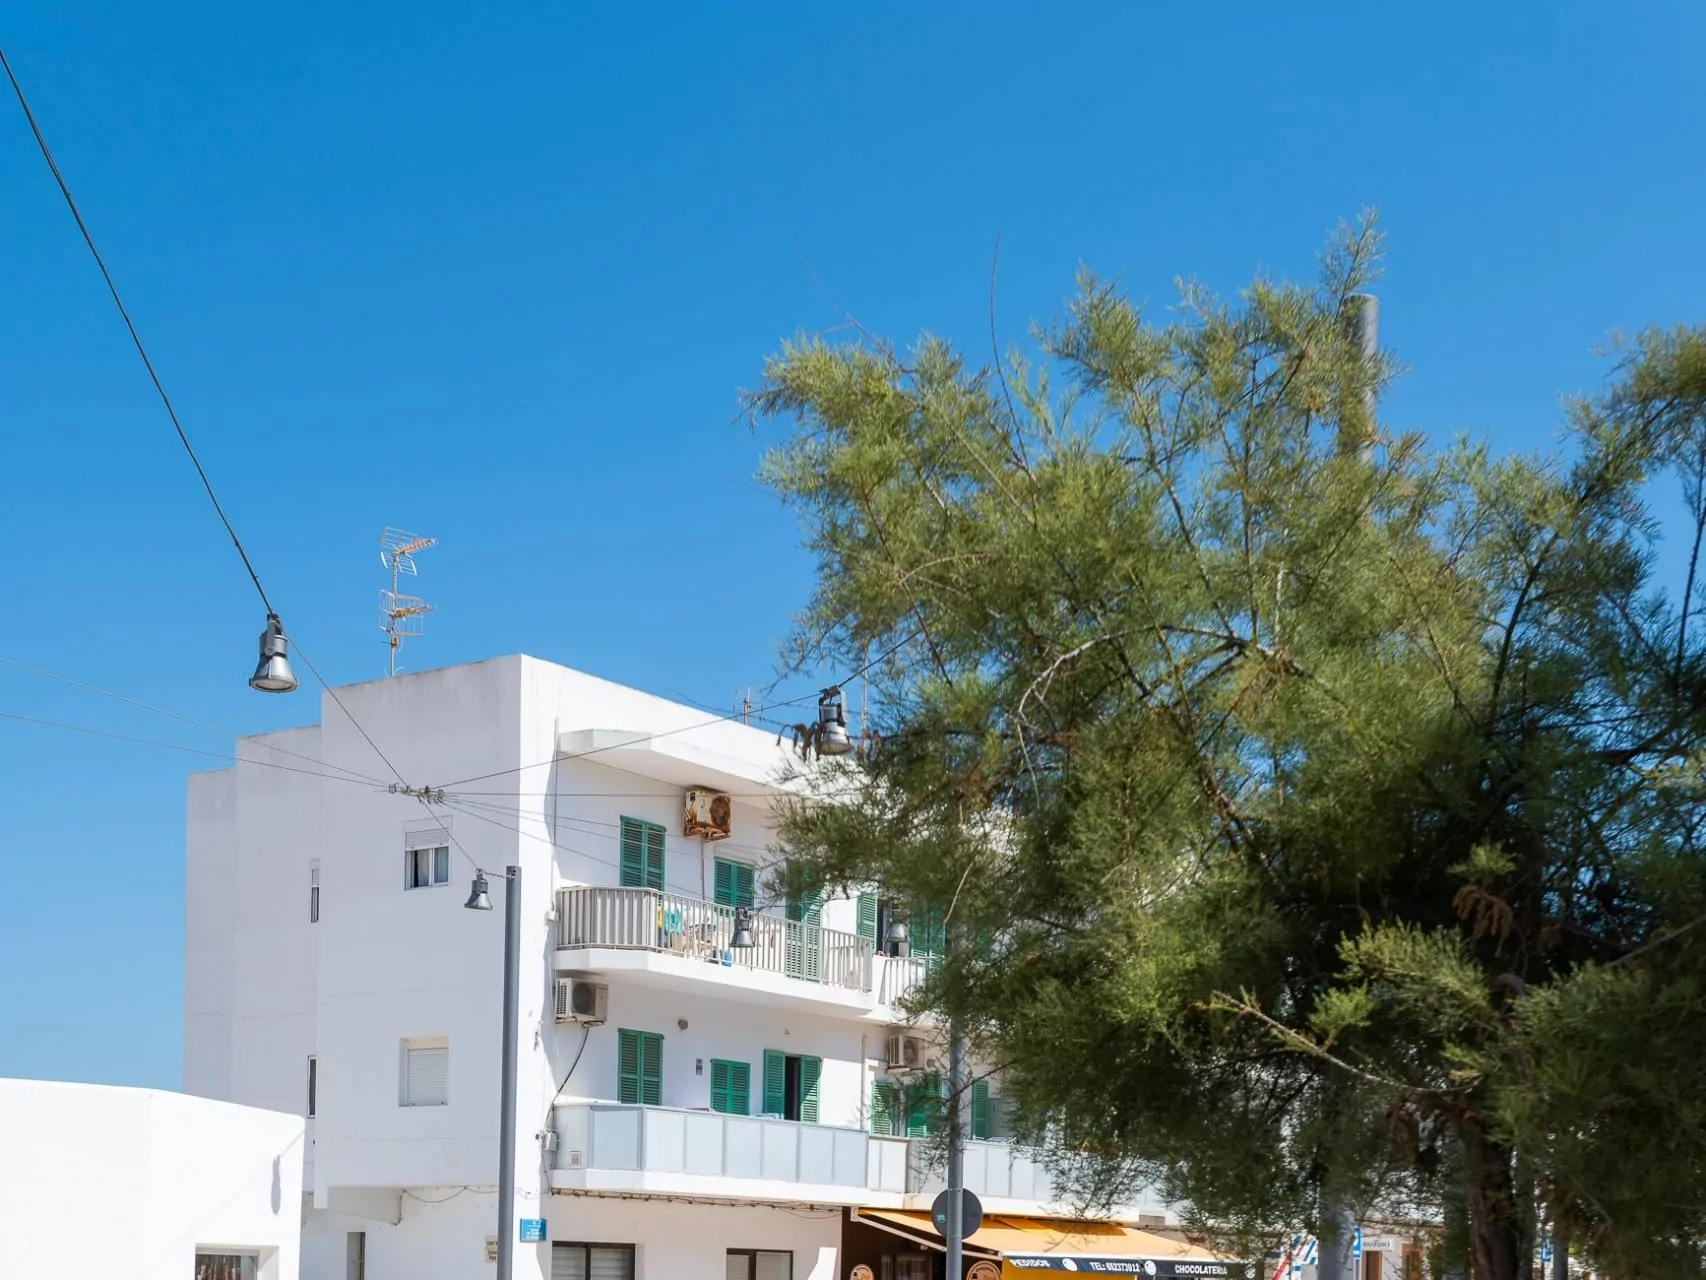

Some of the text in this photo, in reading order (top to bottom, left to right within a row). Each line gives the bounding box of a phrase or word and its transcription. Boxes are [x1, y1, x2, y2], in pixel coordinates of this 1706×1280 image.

[1009, 1258, 1051, 1268] PEDIDOS
[1088, 1261, 1106, 1271] TEL:
[1174, 1264, 1228, 1275] CHOCOLATERIA
